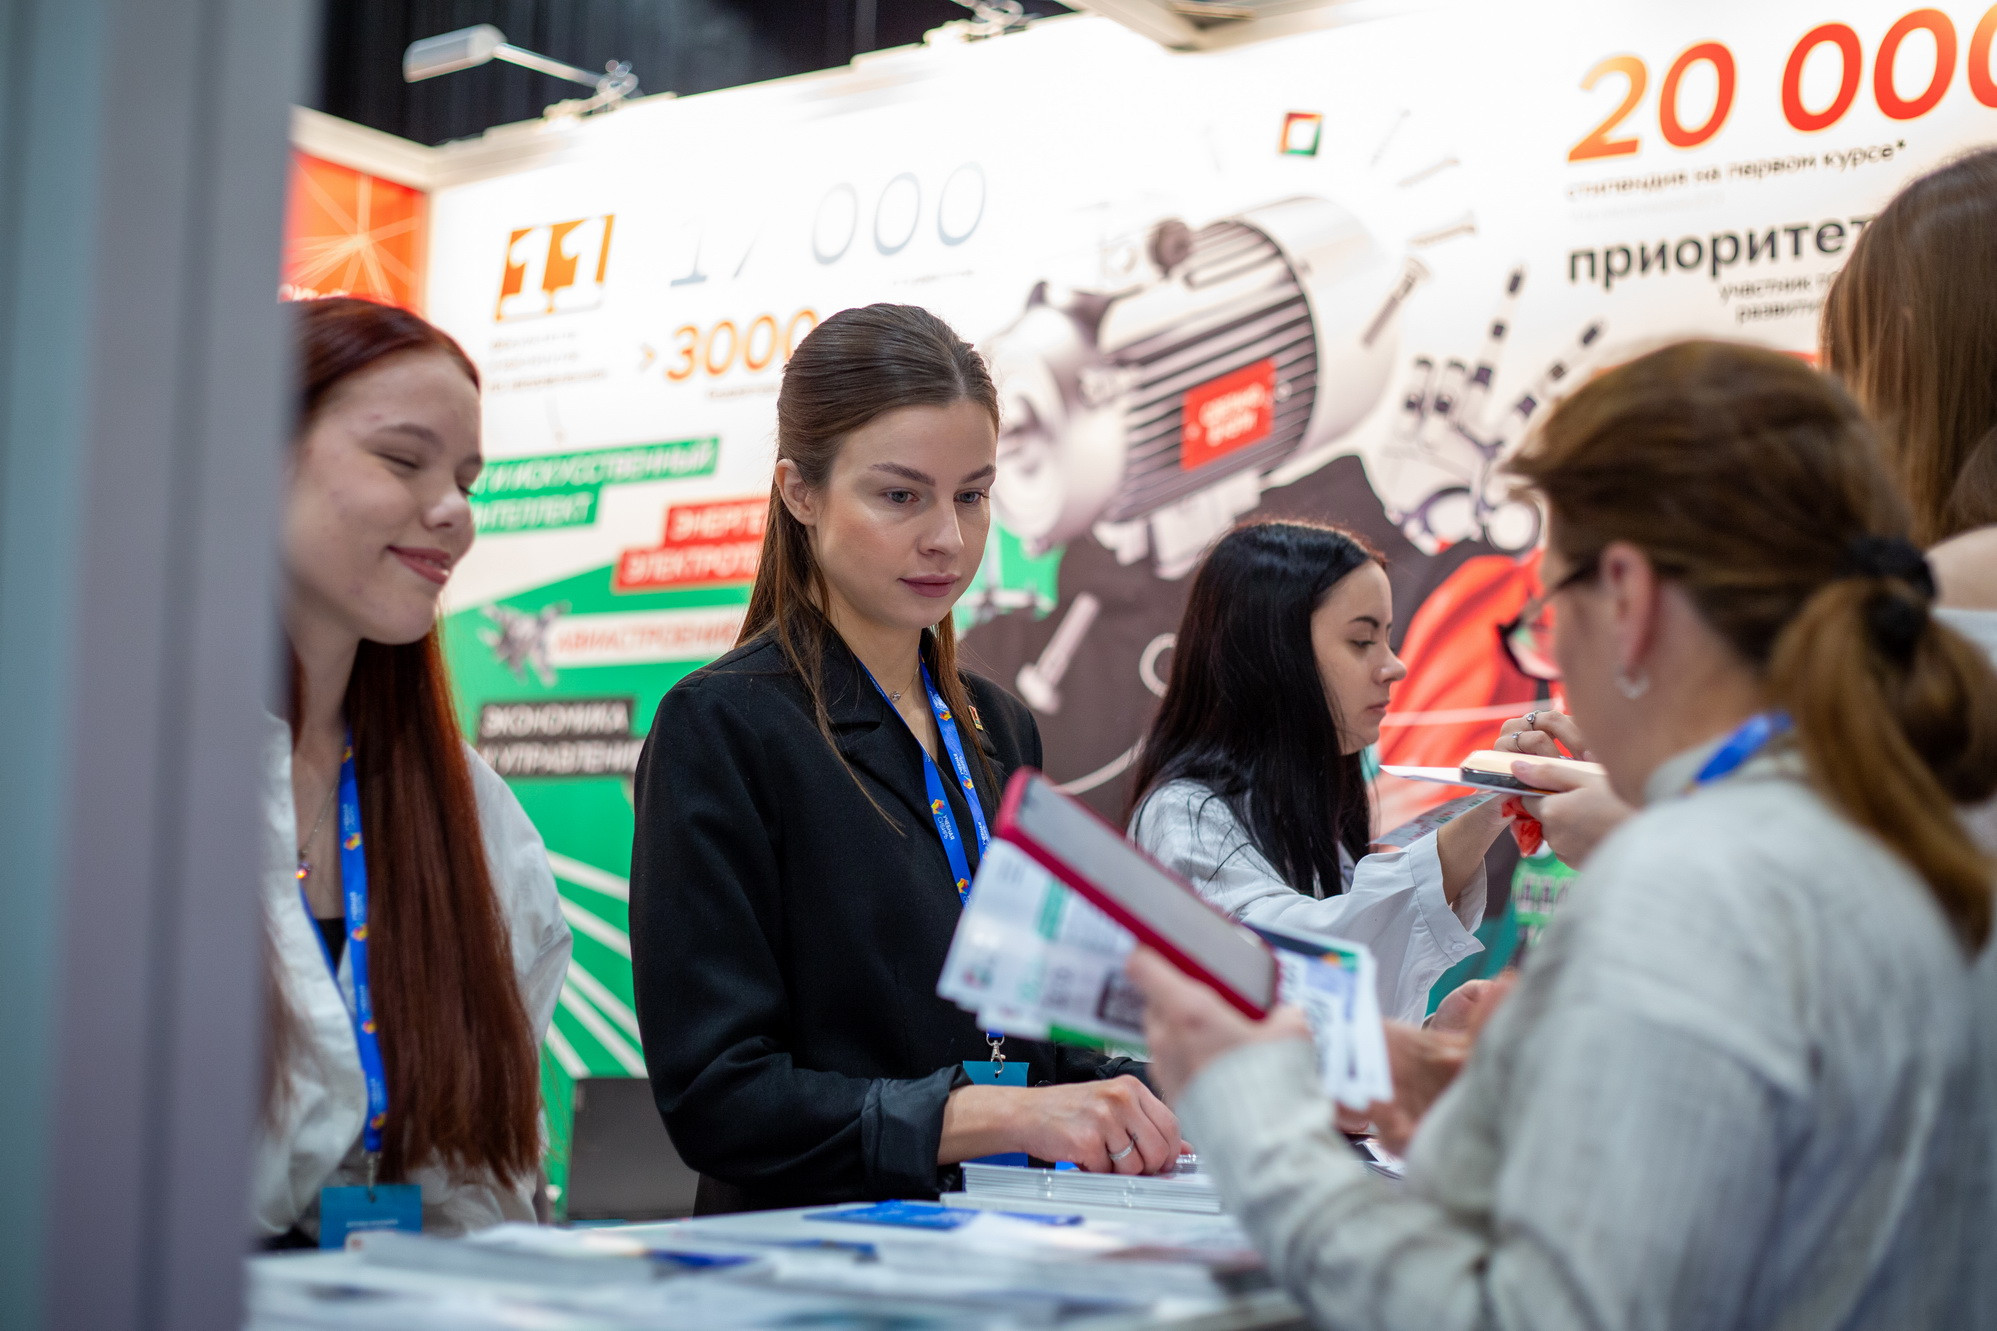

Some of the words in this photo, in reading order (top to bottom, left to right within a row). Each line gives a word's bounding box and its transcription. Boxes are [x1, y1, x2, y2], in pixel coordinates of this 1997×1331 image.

[1567, 40, 1736, 162] 20
[811, 161, 986, 266] 000
[482, 703, 628, 737] ЭКОНОМИКА
[499, 739, 645, 775] УПРАВЛЕНИ
